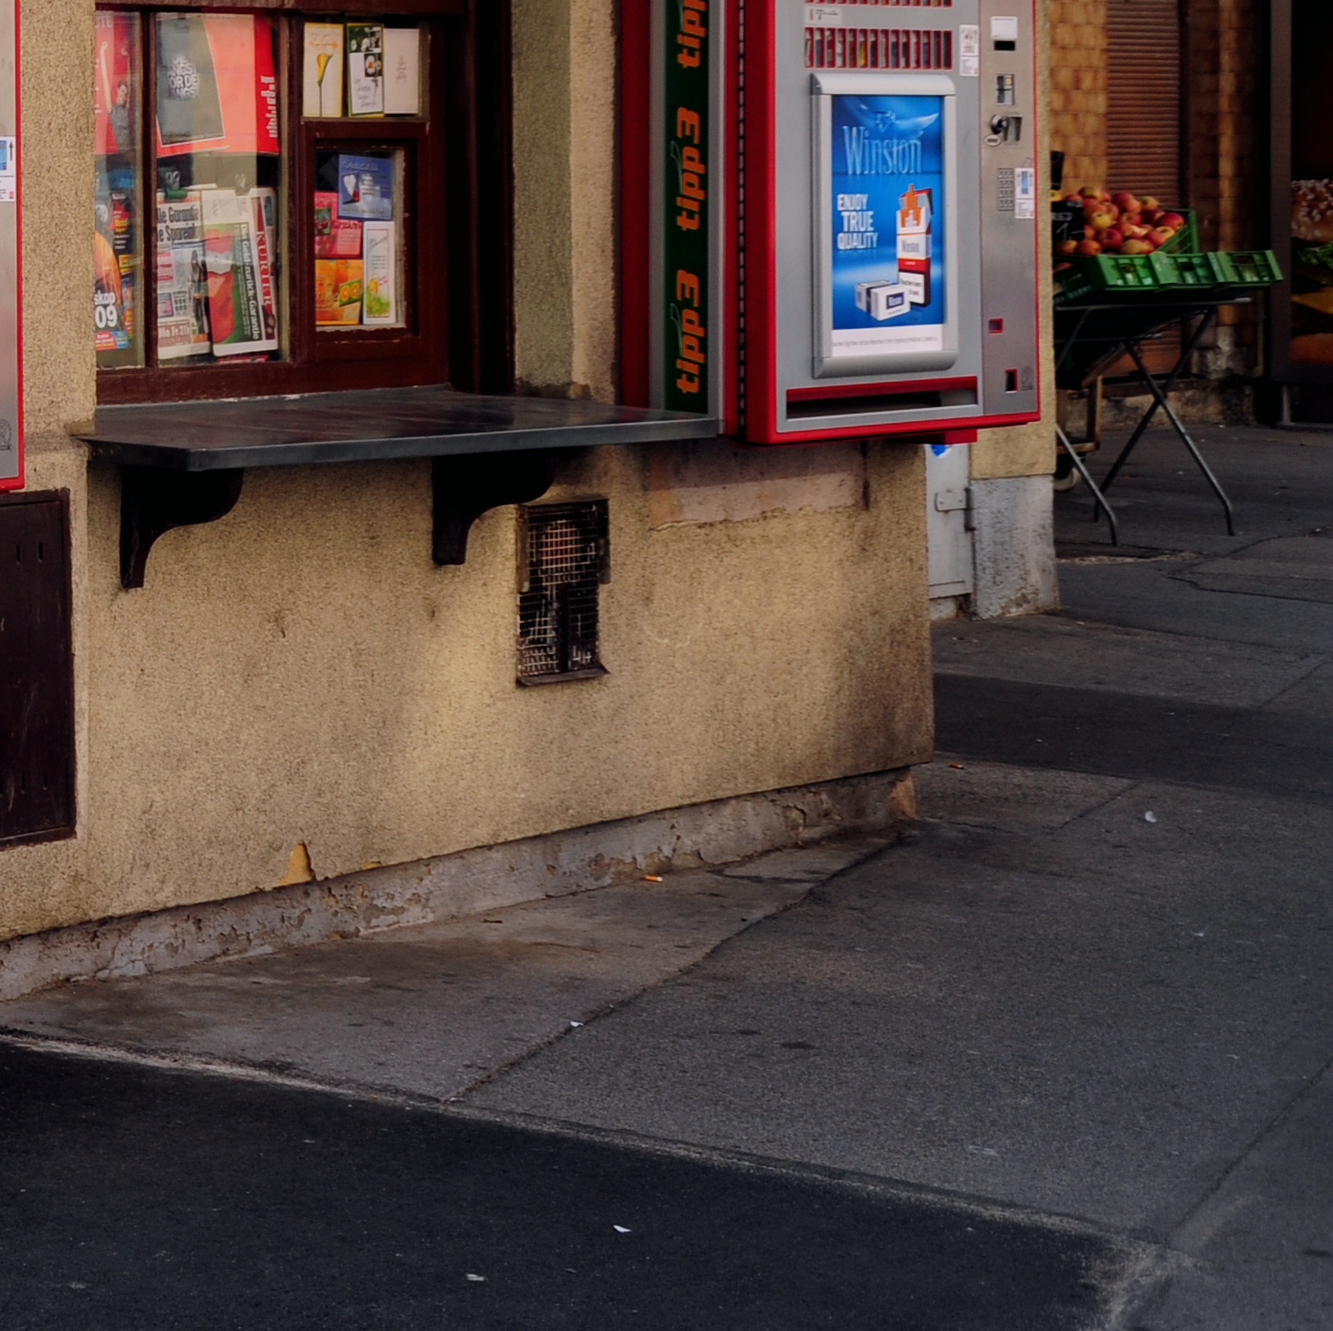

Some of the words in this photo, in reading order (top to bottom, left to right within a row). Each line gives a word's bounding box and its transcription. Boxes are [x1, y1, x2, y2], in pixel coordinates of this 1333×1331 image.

[676, 106, 707, 232] tipp3
[842, 125, 923, 176] Winston
[837, 194, 869, 212] ENJOY
[841, 210, 875, 232] TRUE
[837, 231, 879, 251] QUALITY
[256, 230, 272, 307] KURIER
[676, 269, 707, 394] tipp3
